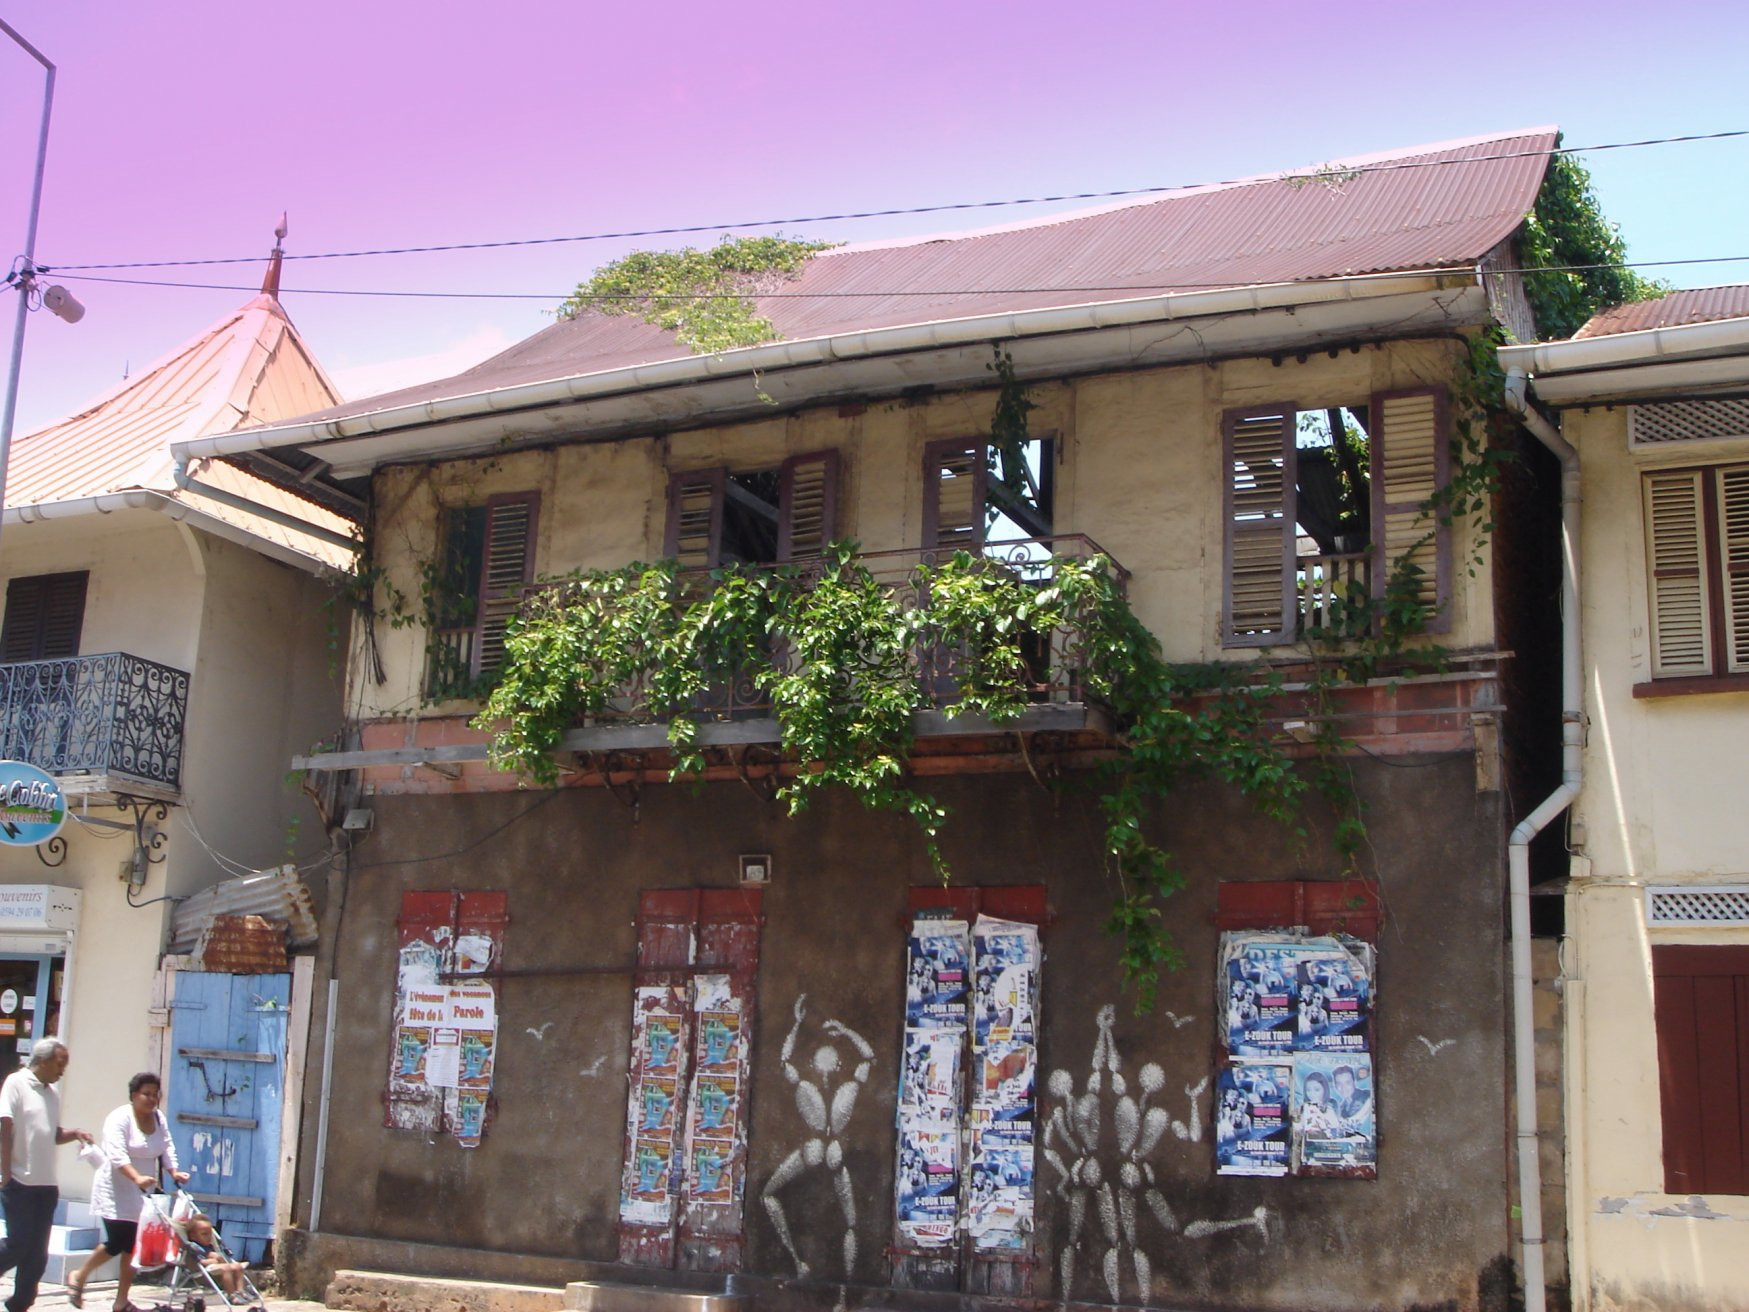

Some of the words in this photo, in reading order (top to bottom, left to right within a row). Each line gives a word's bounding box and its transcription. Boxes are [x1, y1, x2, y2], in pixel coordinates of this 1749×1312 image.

[426, 1009, 437, 1021] de
[453, 1005, 485, 1019] Parole
[947, 1003, 966, 1013] TOUR
[1244, 1030, 1271, 1041] E-ZOUK
[1272, 1030, 1293, 1040] TOUR
[1314, 1035, 1342, 1046] E-ZOUK
[1342, 1035, 1364, 1045] TOUR
[1013, 1120, 1032, 1130] TOUR
[1237, 1140, 1264, 1151] E-ZOUK
[1264, 1141, 1286, 1151] TOUR
[939, 1196, 956, 1206] TOUR
